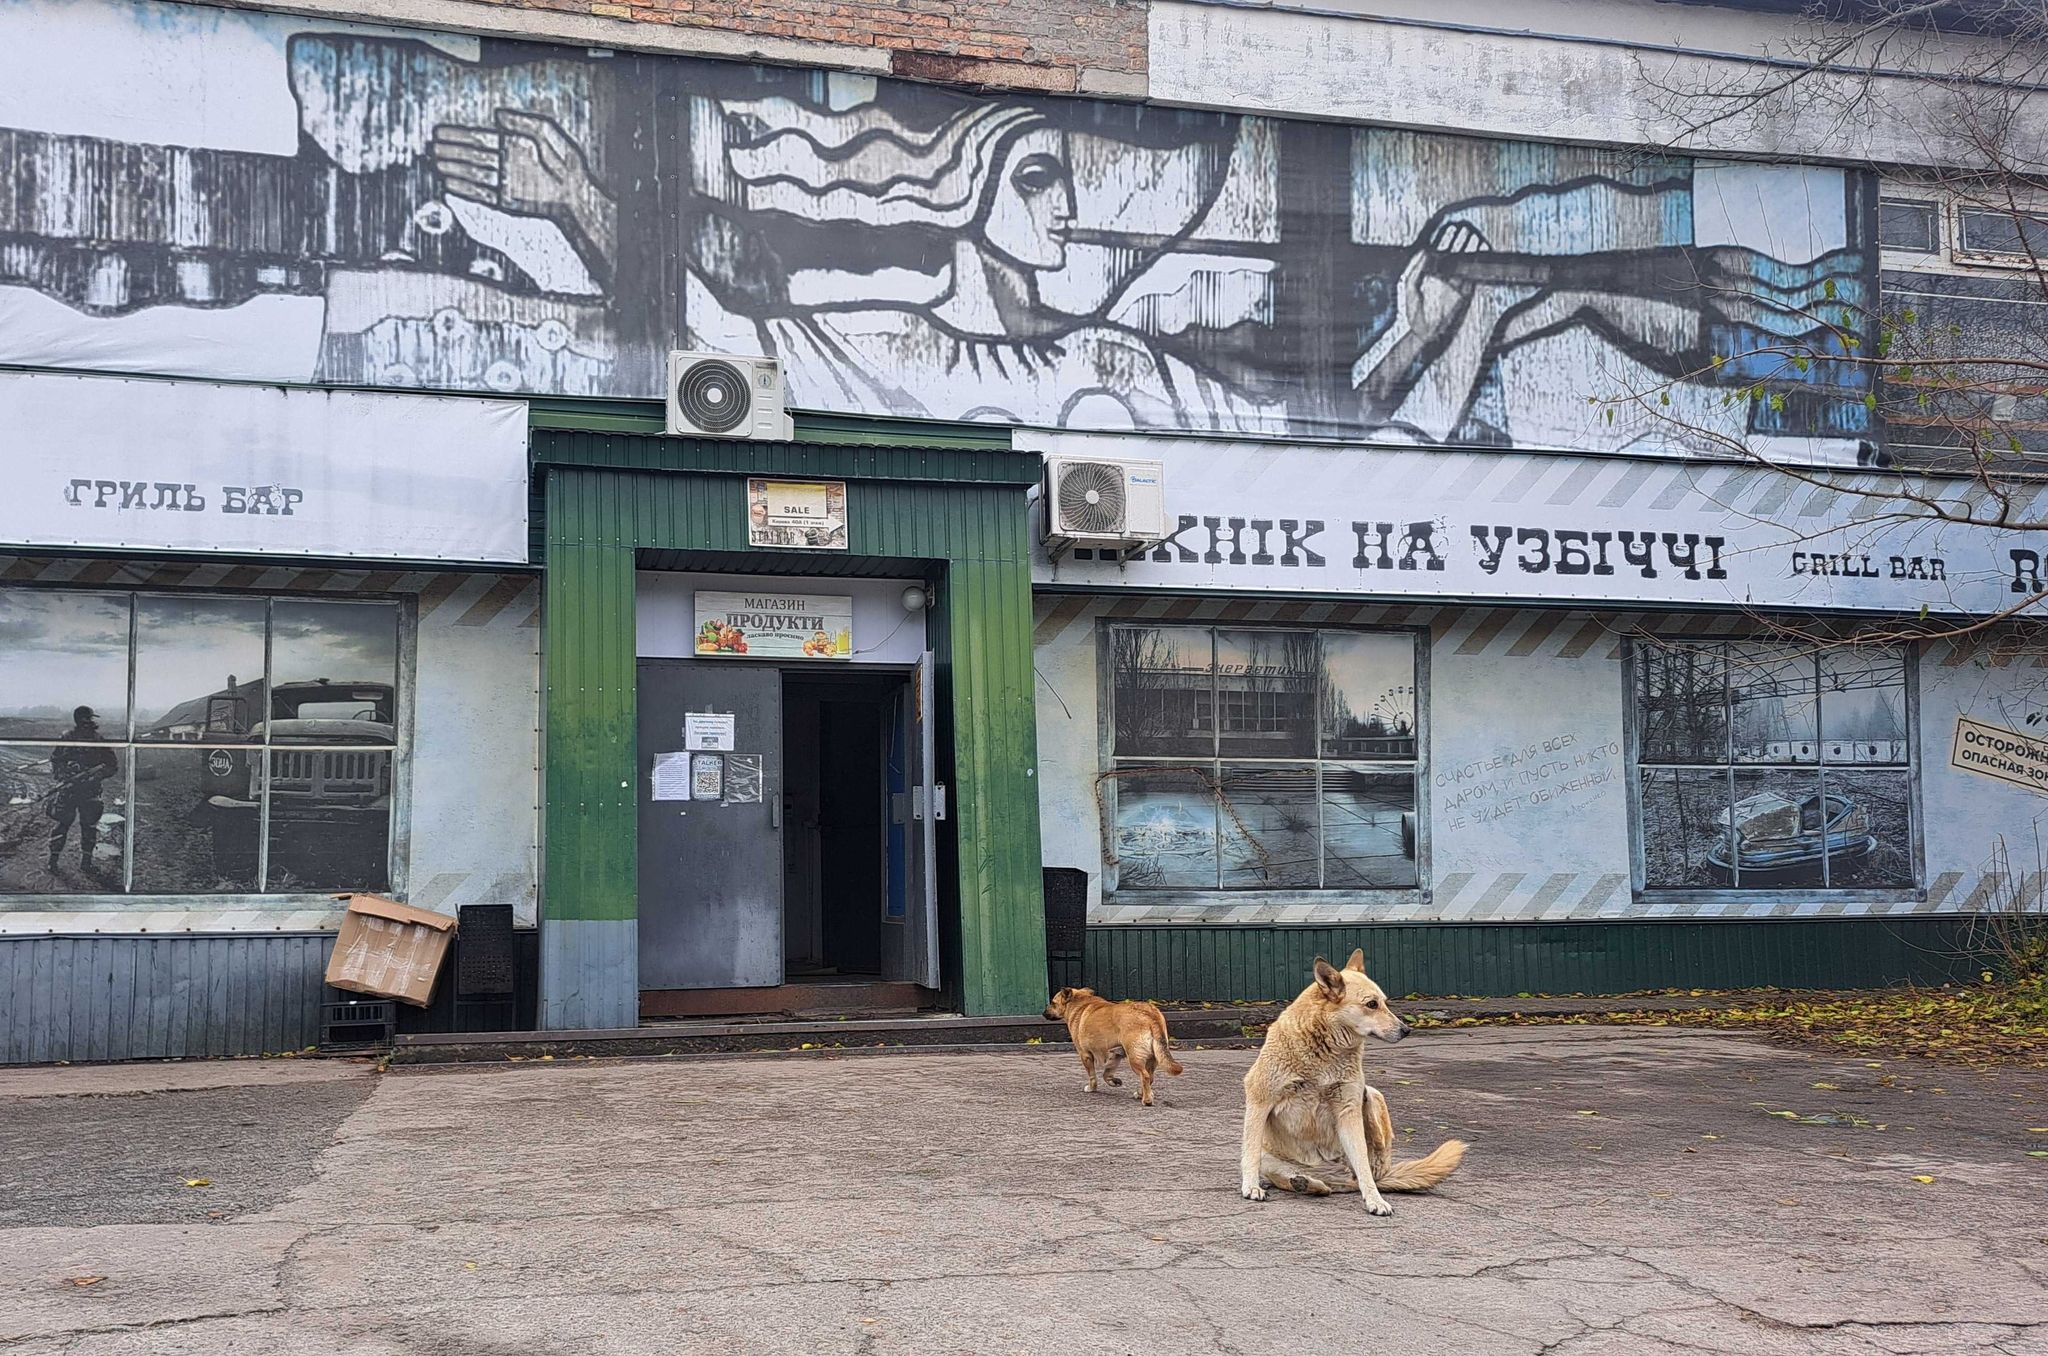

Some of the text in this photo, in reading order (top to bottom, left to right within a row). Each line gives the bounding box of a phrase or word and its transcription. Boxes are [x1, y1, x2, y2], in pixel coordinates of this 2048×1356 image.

[69, 478, 304, 515] ГРИЛЬ БАР
[783, 506, 810, 515] SALE
[1352, 519, 1446, 571] НА
[1470, 524, 1728, 580] УЗБІЧЧІ
[1792, 552, 1947, 580] GRILL BAR
[2010, 549, 2048, 593] R
[744, 597, 805, 611] МАГАЗИН
[726, 613, 824, 632] ПРОДУКТИ
[1435, 731, 1578, 788] СЧАСТЬЕ ДЛЯ ВСЕХ
[1503, 777, 1514, 791] И
[1519, 761, 1569, 788] ПУСТЬ
[1573, 741, 1619, 768] НИКТО
[1962, 749, 2024, 775] ОПАСНАЯ
[1448, 816, 1466, 832] НЕ
